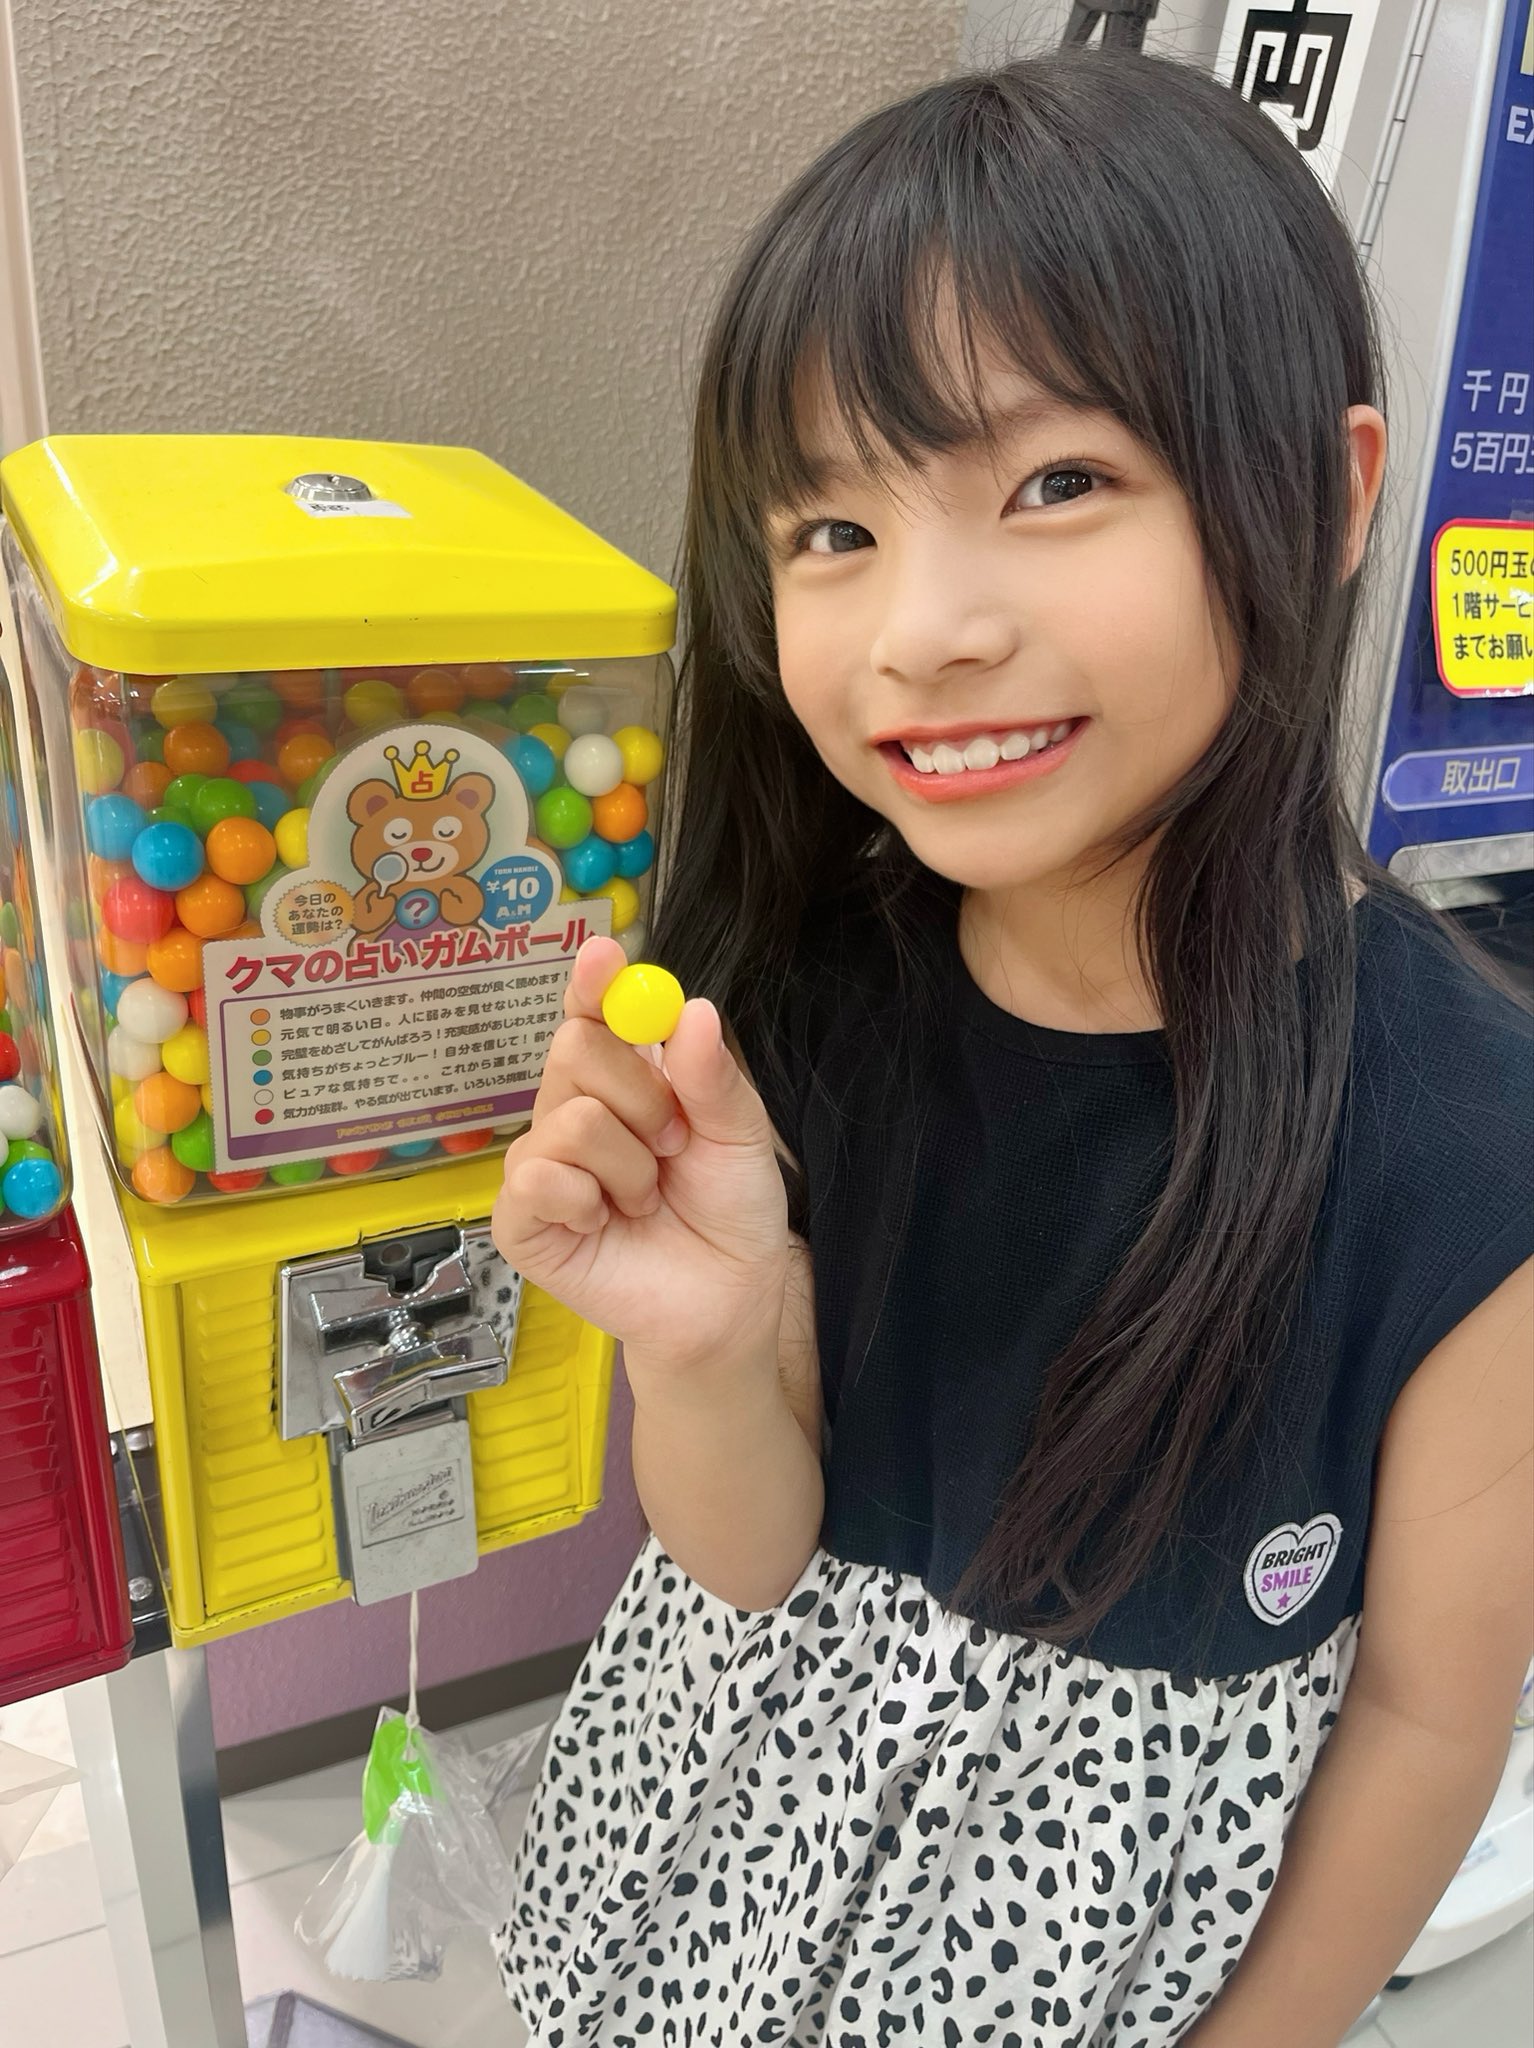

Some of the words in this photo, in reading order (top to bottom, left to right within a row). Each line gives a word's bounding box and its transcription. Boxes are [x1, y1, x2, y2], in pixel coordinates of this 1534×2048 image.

[1451, 431, 1534, 474] 5百円
[1451, 550, 1534, 578] 500円玉
[411, 770, 434, 793] 占
[1441, 757, 1521, 795] 取出口
[294, 893, 336, 907] 今日の
[486, 877, 540, 901] ¥10
[288, 906, 344, 921] あなたの
[291, 919, 343, 935] 運勢は？
[225, 918, 593, 993] クマの占いガムボール
[280, 990, 566, 1041] 元気で明るい日。人に弱みを見せないように
[1261, 1541, 1328, 1570] BRIGHT
[1261, 1566, 1313, 1593] SMILE
